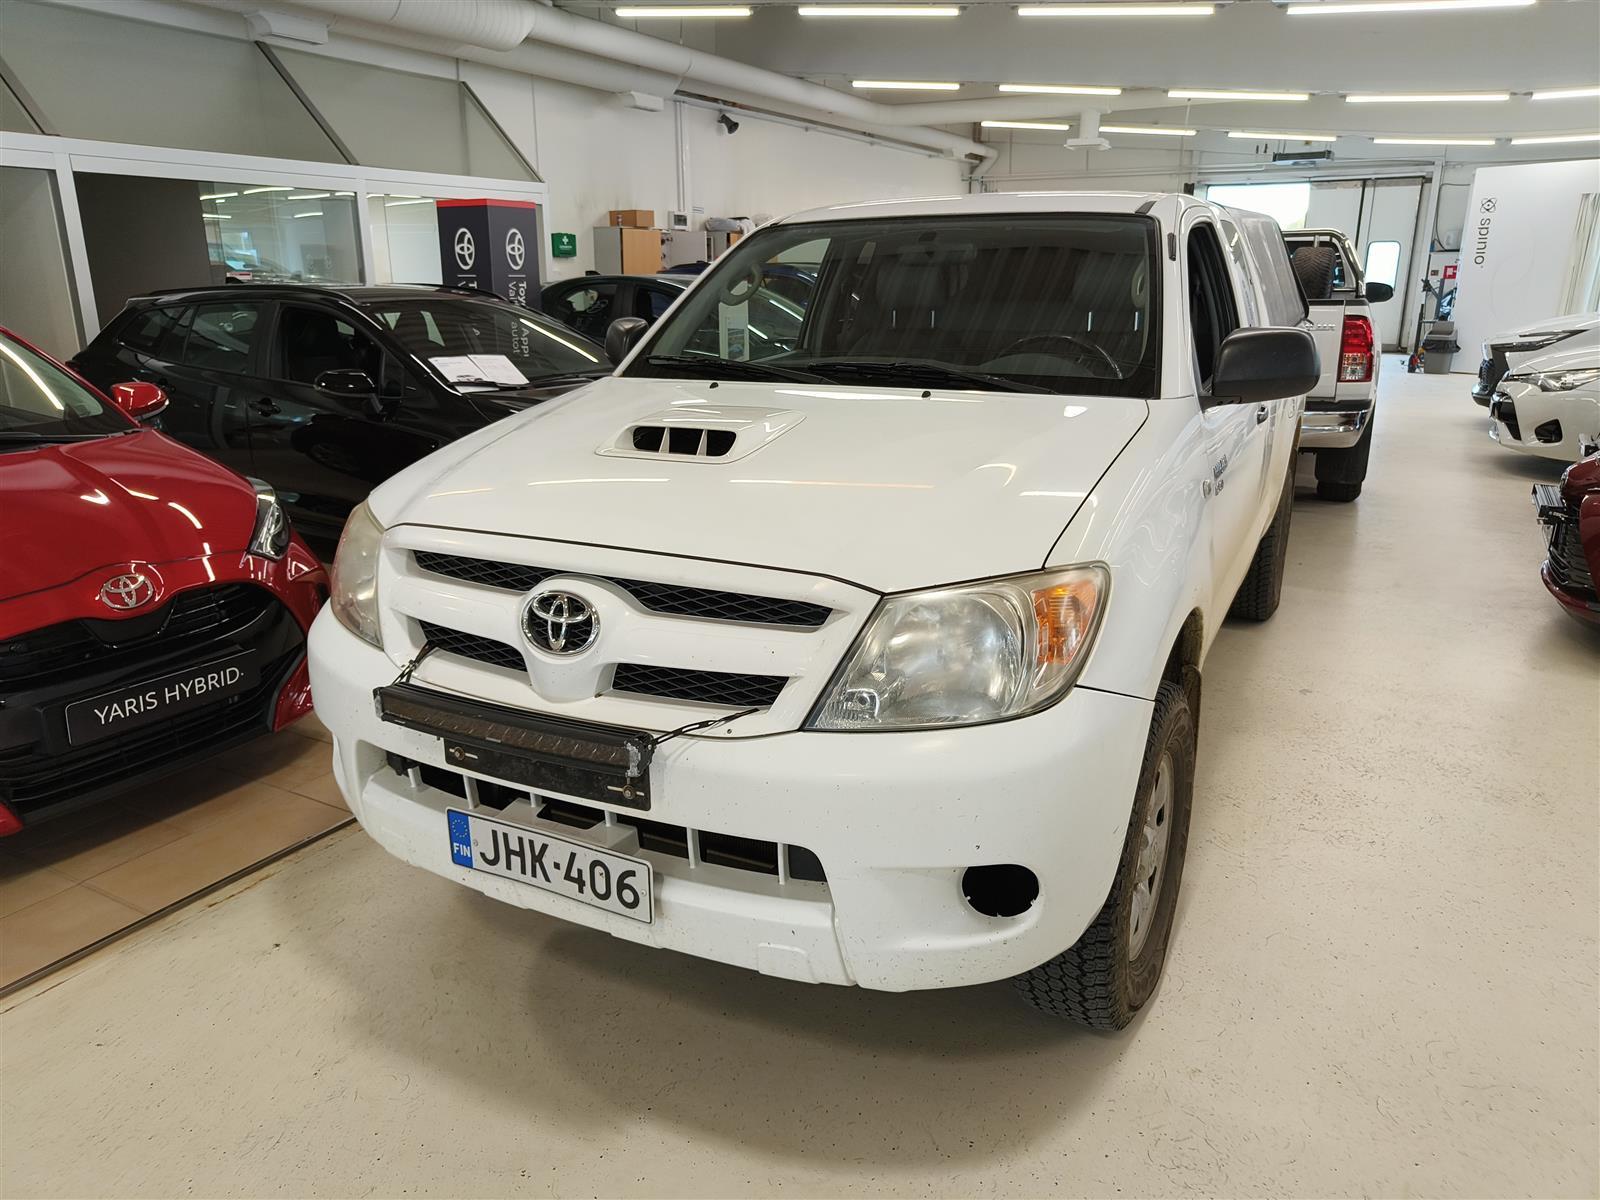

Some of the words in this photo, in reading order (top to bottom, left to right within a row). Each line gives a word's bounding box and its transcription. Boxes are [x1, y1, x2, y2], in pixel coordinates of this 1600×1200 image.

[93, 691, 159, 725] YARIS
[452, 842, 471, 858] FIN
[479, 829, 640, 910] JHK-406
